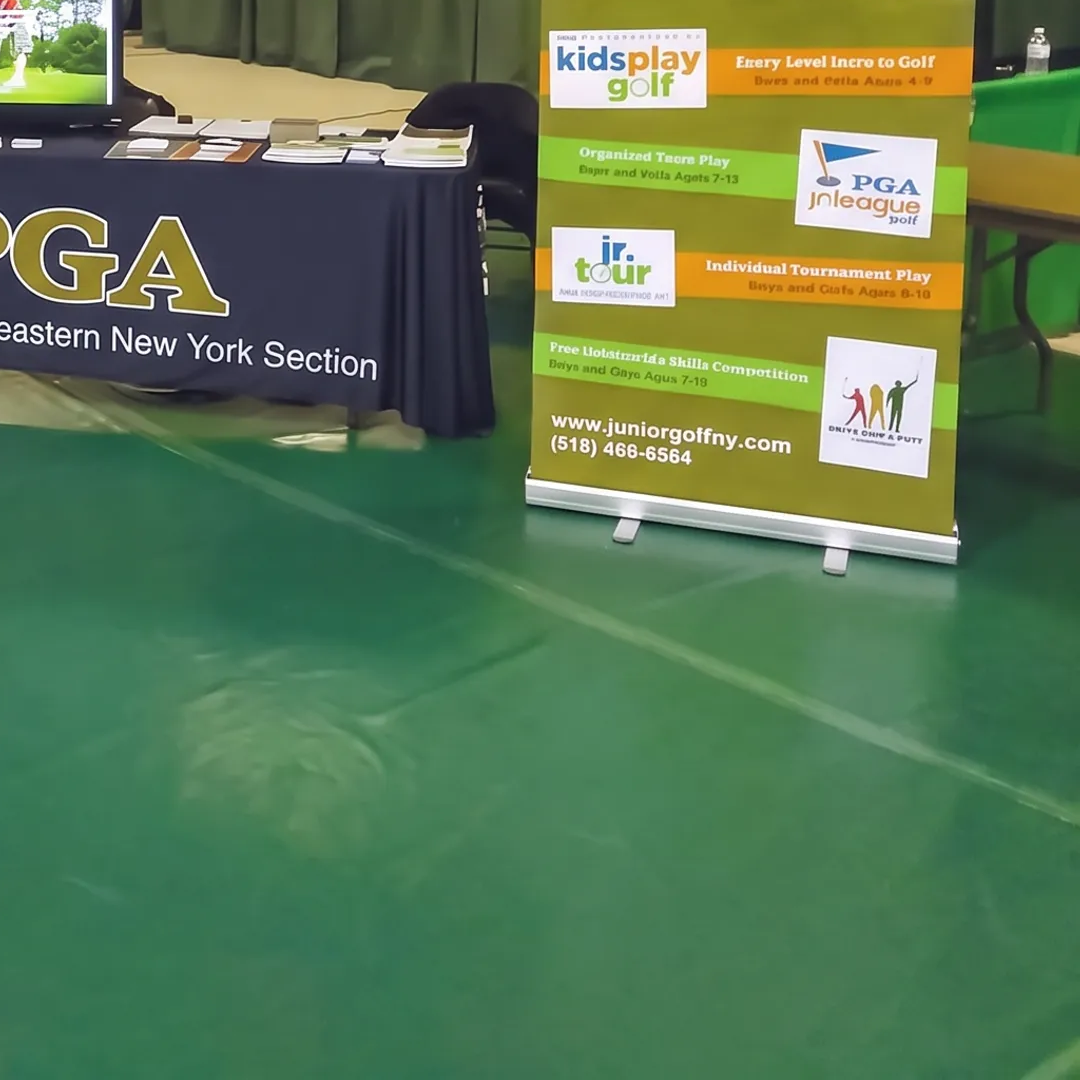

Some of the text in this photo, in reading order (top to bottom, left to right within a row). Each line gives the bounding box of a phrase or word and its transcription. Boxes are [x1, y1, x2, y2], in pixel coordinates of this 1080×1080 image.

[556, 45, 701, 77] kidsplay
[786, 55, 827, 69] Level
[878, 56, 894, 69] to
[898, 55, 936, 69] Golf
[607, 71, 675, 102] golf
[793, 75, 819, 86] and
[579, 146, 652, 162] Organized
[699, 154, 731, 169] Play
[613, 168, 637, 179] and
[712, 173, 739, 184] 7-13
[852, 174, 921, 196] PGA
[574, 257, 652, 285] tour
[705, 260, 932, 286] Individual Tournament Play
[787, 283, 815, 294] and
[111, 327, 178, 358] New
[188, 332, 254, 366] York
[263, 341, 379, 381] Section
[549, 341, 580, 355] Free
[582, 363, 607, 376] and
[550, 434, 598, 459] (518)
[897, 435, 924, 445] PUTT
